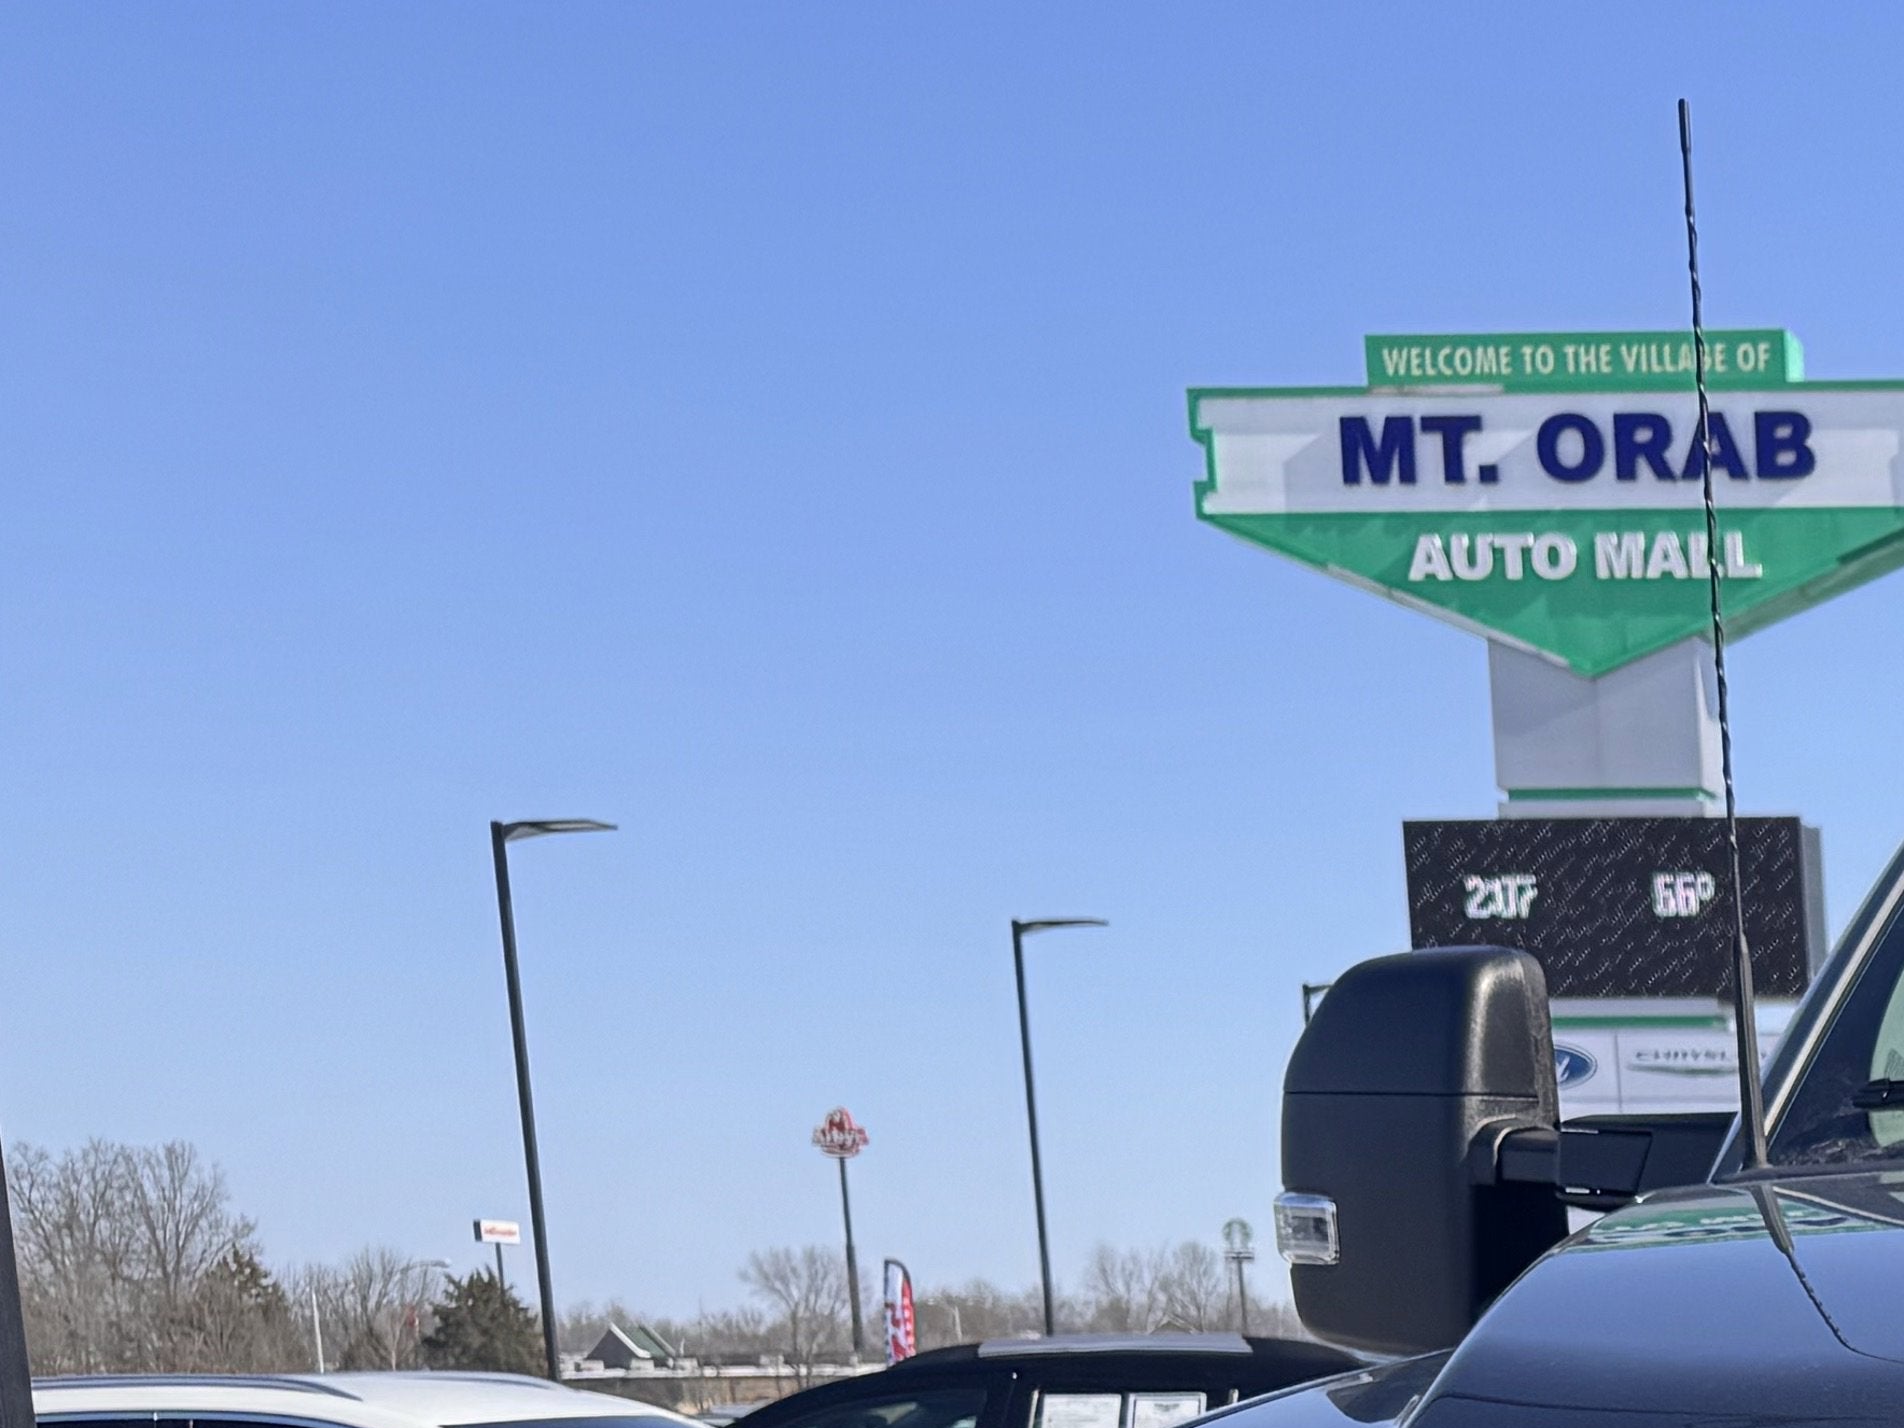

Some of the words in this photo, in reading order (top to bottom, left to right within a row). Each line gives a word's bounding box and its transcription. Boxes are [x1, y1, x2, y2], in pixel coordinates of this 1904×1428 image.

[1382, 345, 1513, 378] WELCOME
[1521, 345, 1555, 375] TO
[1563, 343, 1613, 374] THE
[1736, 341, 1771, 373] OF
[1338, 413, 1501, 487] MT.
[1536, 409, 1816, 484] ORAB
[1407, 530, 1578, 582] AUTO
[1594, 530, 1764, 581] MALL
